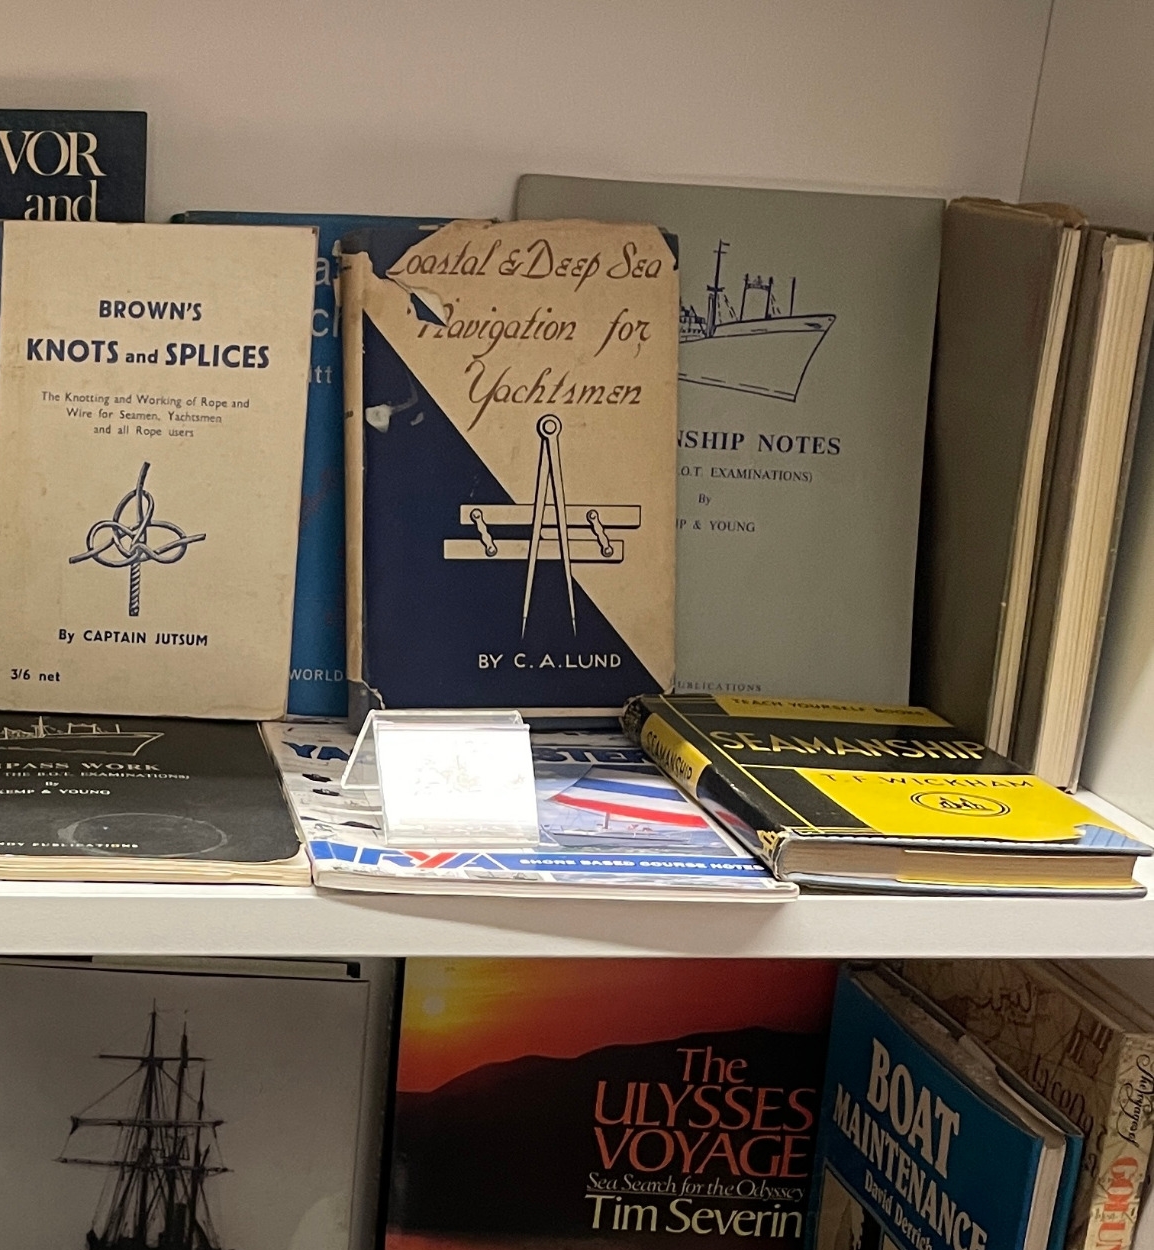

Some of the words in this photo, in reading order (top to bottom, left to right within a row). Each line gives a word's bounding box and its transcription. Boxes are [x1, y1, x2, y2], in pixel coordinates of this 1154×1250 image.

[99, 300, 202, 321] BROWN'S
[27, 338, 118, 363] KNOTS
[126, 348, 157, 364] and
[165, 343, 270, 369] SPLICES
[41, 391, 60, 402] The
[65, 392, 109, 405] Knotting
[114, 394, 132, 405] and
[137, 394, 182, 408] Working
[186, 397, 197, 407] of
[201, 397, 228, 410] Rope
[231, 398, 250, 409] and
[93, 425, 111, 436] and
[117, 426, 129, 436] all
[136, 427, 162, 439] Rope
[168, 428, 194, 438] users
[757, 434, 842, 456] NOTES
[711, 467, 813, 482] EXAMINATIONS)
[59, 630, 75, 643] By
[83, 630, 146, 645] CAPTAIN
[154, 632, 208, 647] JUTSUM
[710, 731, 985, 760] SEAMANSHIP
[81, 762, 161, 772] WORK
[520, 858, 577, 866] SHORE
[582, 859, 636, 867] BASED
[641, 860, 707, 868] COURSE
[712, 863, 766, 871] NOTES
[677, 1046, 748, 1083] The
[595, 1080, 816, 1132] ULYSSES
[866, 1038, 960, 1179] BOAT
[594, 1127, 810, 1177] VOYAGE
[587, 1172, 617, 1191] Sea
[621, 1173, 676, 1193] Search
[679, 1176, 704, 1197] for
[708, 1178, 734, 1197] the
[736, 1180, 805, 1202] Odyssey
[864, 1169, 895, 1217] David
[585, 1194, 657, 1231] Tim
[666, 1199, 801, 1237] Severin
